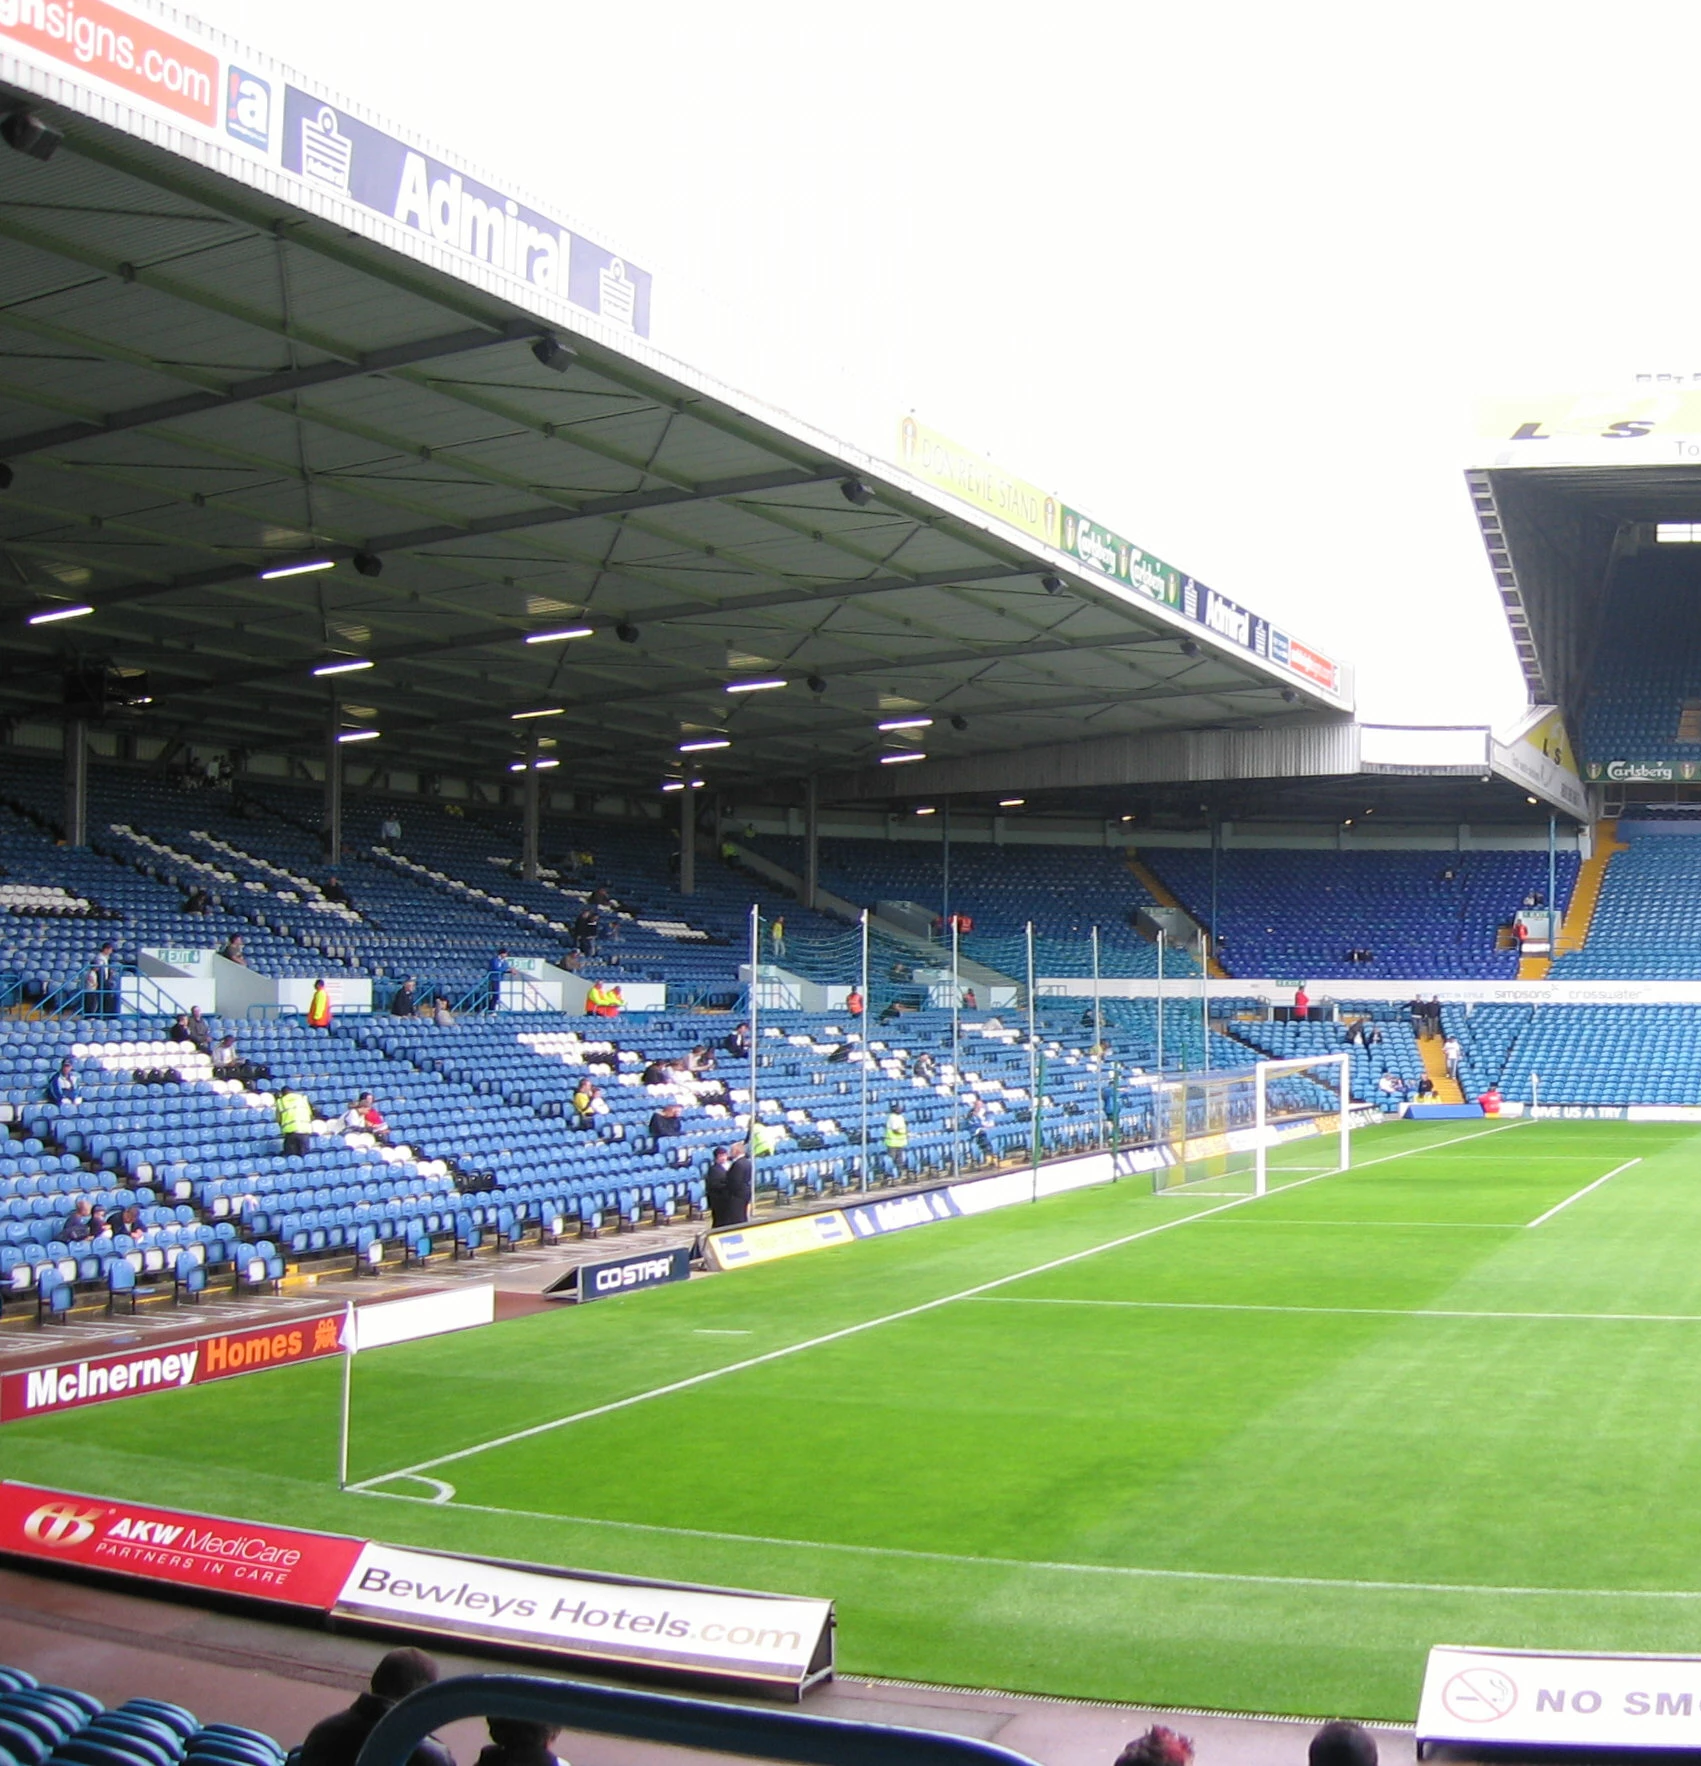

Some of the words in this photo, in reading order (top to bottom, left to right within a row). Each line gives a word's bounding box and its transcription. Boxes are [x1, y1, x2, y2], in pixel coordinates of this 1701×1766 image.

[393, 150, 564, 300] Admiral
[999, 479, 1038, 524] STAND
[1077, 519, 1117, 575] Carlsberg
[1130, 548, 1165, 601] Carlsberg
[1205, 590, 1250, 646] Admiral
[1607, 761, 1673, 781] Carlsberg
[168, 950, 190, 963] EXIT
[1494, 990, 1552, 1001] simpsons
[1568, 990, 1643, 1000] crosswater
[1530, 1105, 1561, 1119] GIVE
[1563, 1105, 1582, 1119] US
[1583, 1105, 1595, 1119] A
[1598, 1105, 1623, 1119] TRY
[26, 1350, 200, 1408] McInerney
[206, 1329, 303, 1373] Homes
[96, 1542, 195, 1570] PARTNERS
[203, 1561, 225, 1576] IN
[234, 1566, 288, 1585] CARE
[108, 1517, 185, 1545] AKW
[182, 1528, 302, 1567] MediCare
[358, 1566, 537, 1618] Bewleys
[550, 1597, 803, 1651] Hotels.com
[1535, 1688, 1603, 1715] NO
